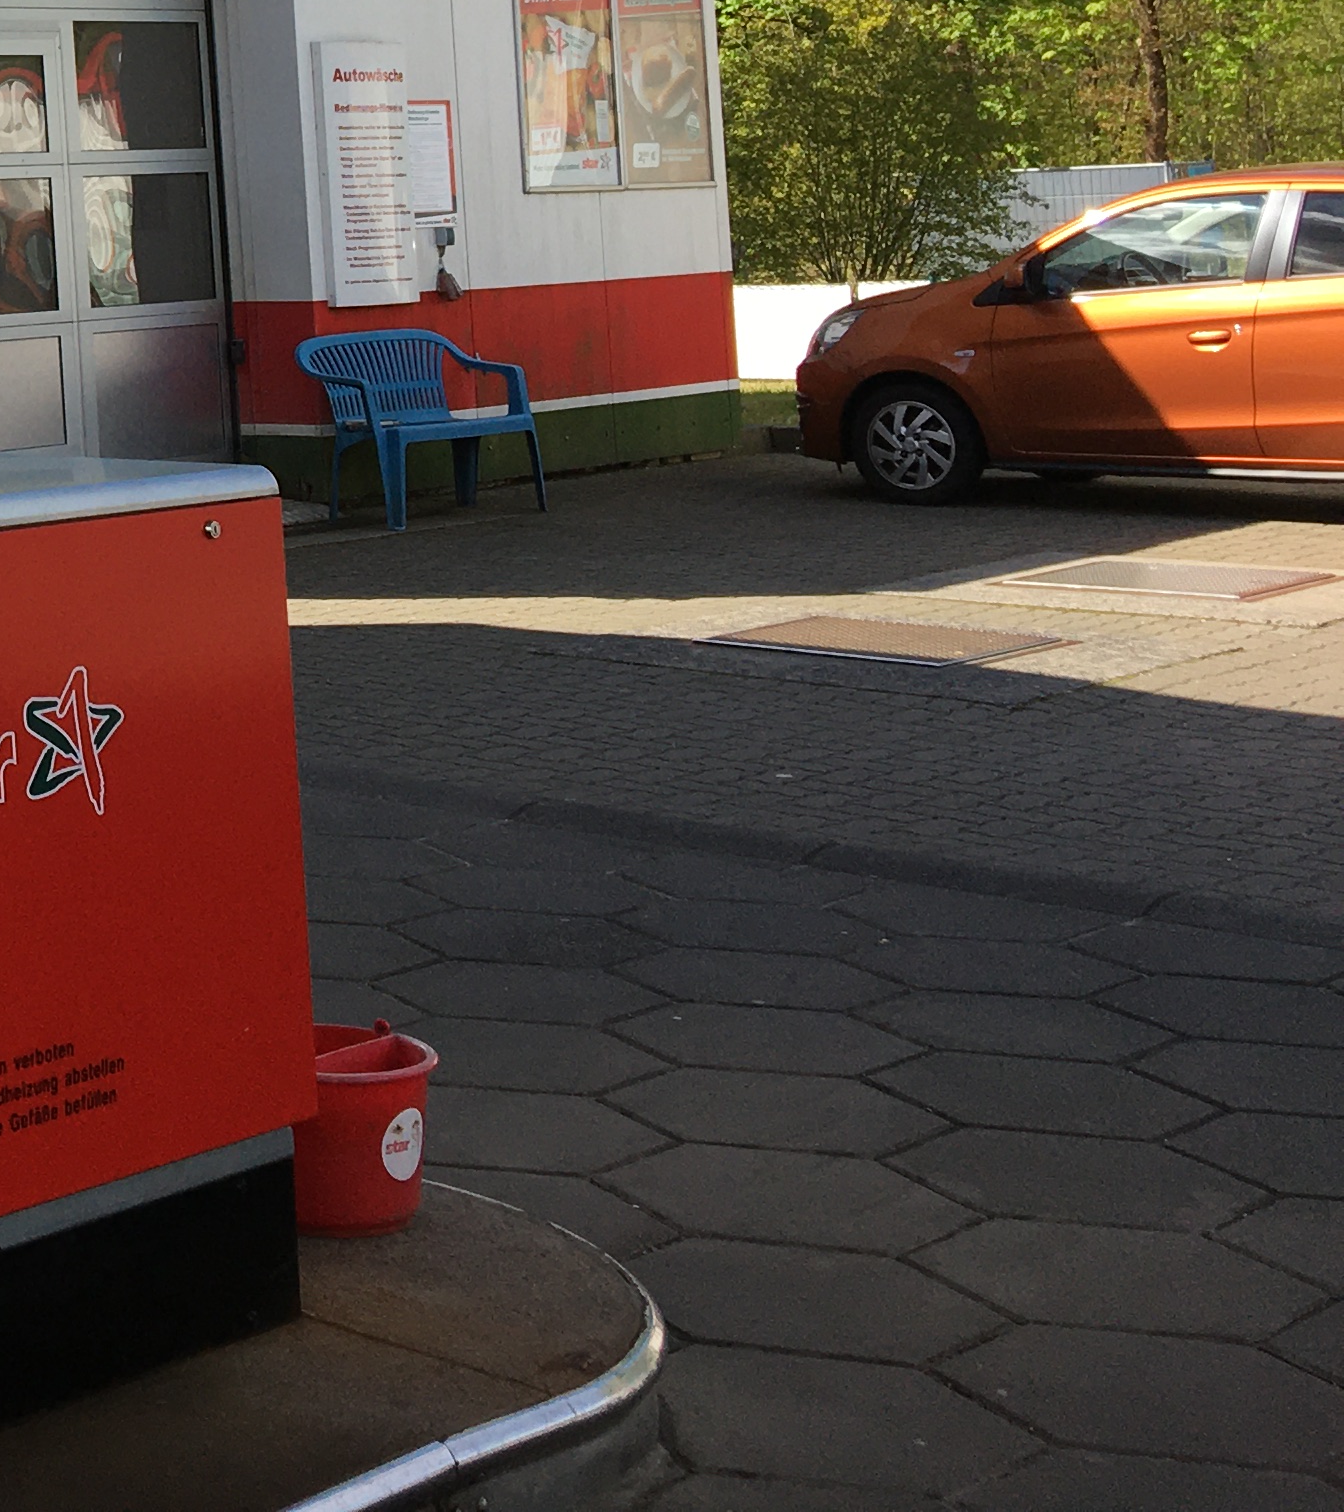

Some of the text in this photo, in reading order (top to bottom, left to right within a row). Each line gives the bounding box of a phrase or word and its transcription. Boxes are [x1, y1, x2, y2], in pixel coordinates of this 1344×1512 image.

[333, 67, 403, 82] Autowäsche
[13, 1042, 74, 1072] verboten
[65, 1057, 125, 1087] abstellen
[9, 1104, 59, 1133] Gefäße
[65, 1088, 117, 1117] befüllen
[385, 1139, 410, 1155] star
